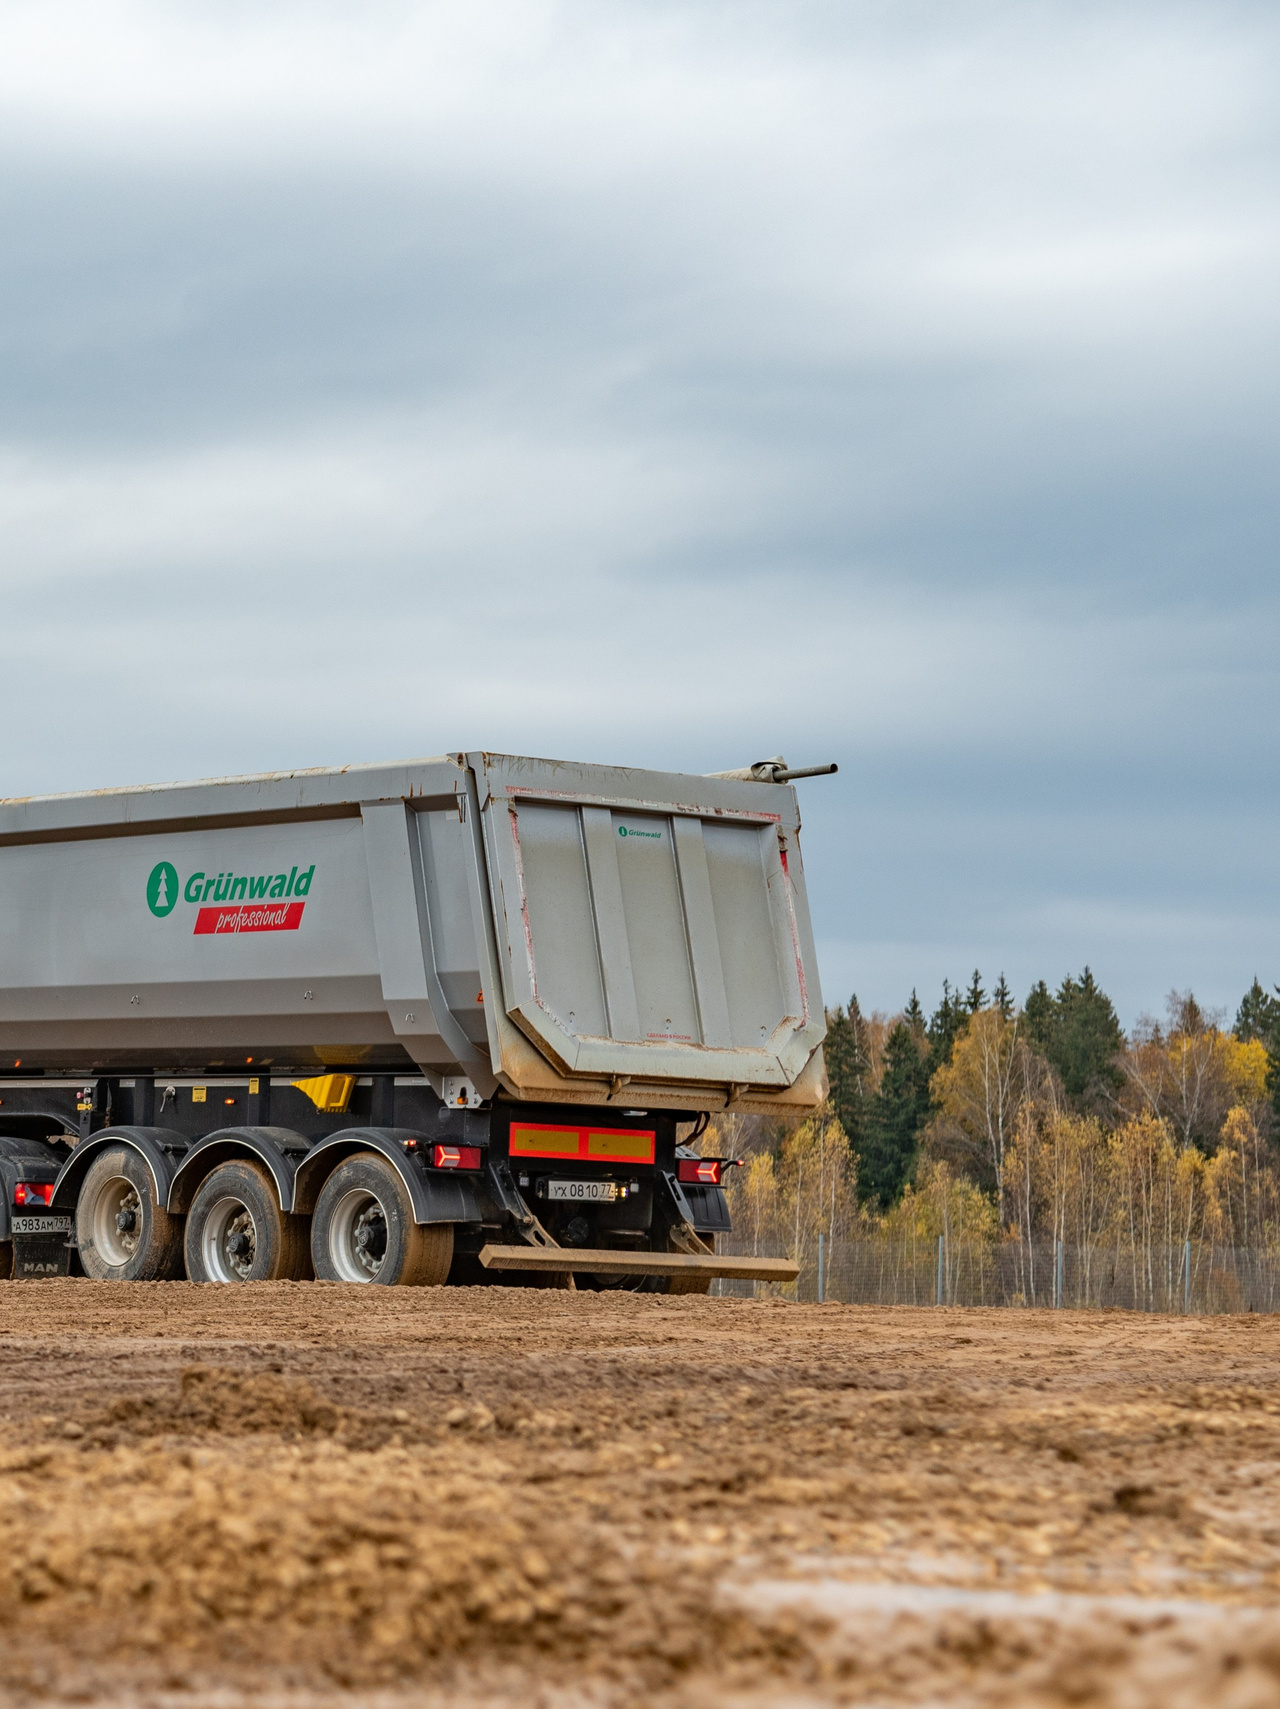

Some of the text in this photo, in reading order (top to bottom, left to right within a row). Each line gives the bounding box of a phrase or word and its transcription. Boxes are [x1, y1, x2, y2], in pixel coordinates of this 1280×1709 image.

[628, 829, 662, 839] Grünwald
[184, 865, 316, 903] Grünwald
[215, 903, 291, 935] professional
[570, 1183, 598, 1198] 0810
[23, 1263, 58, 1273] MAN
